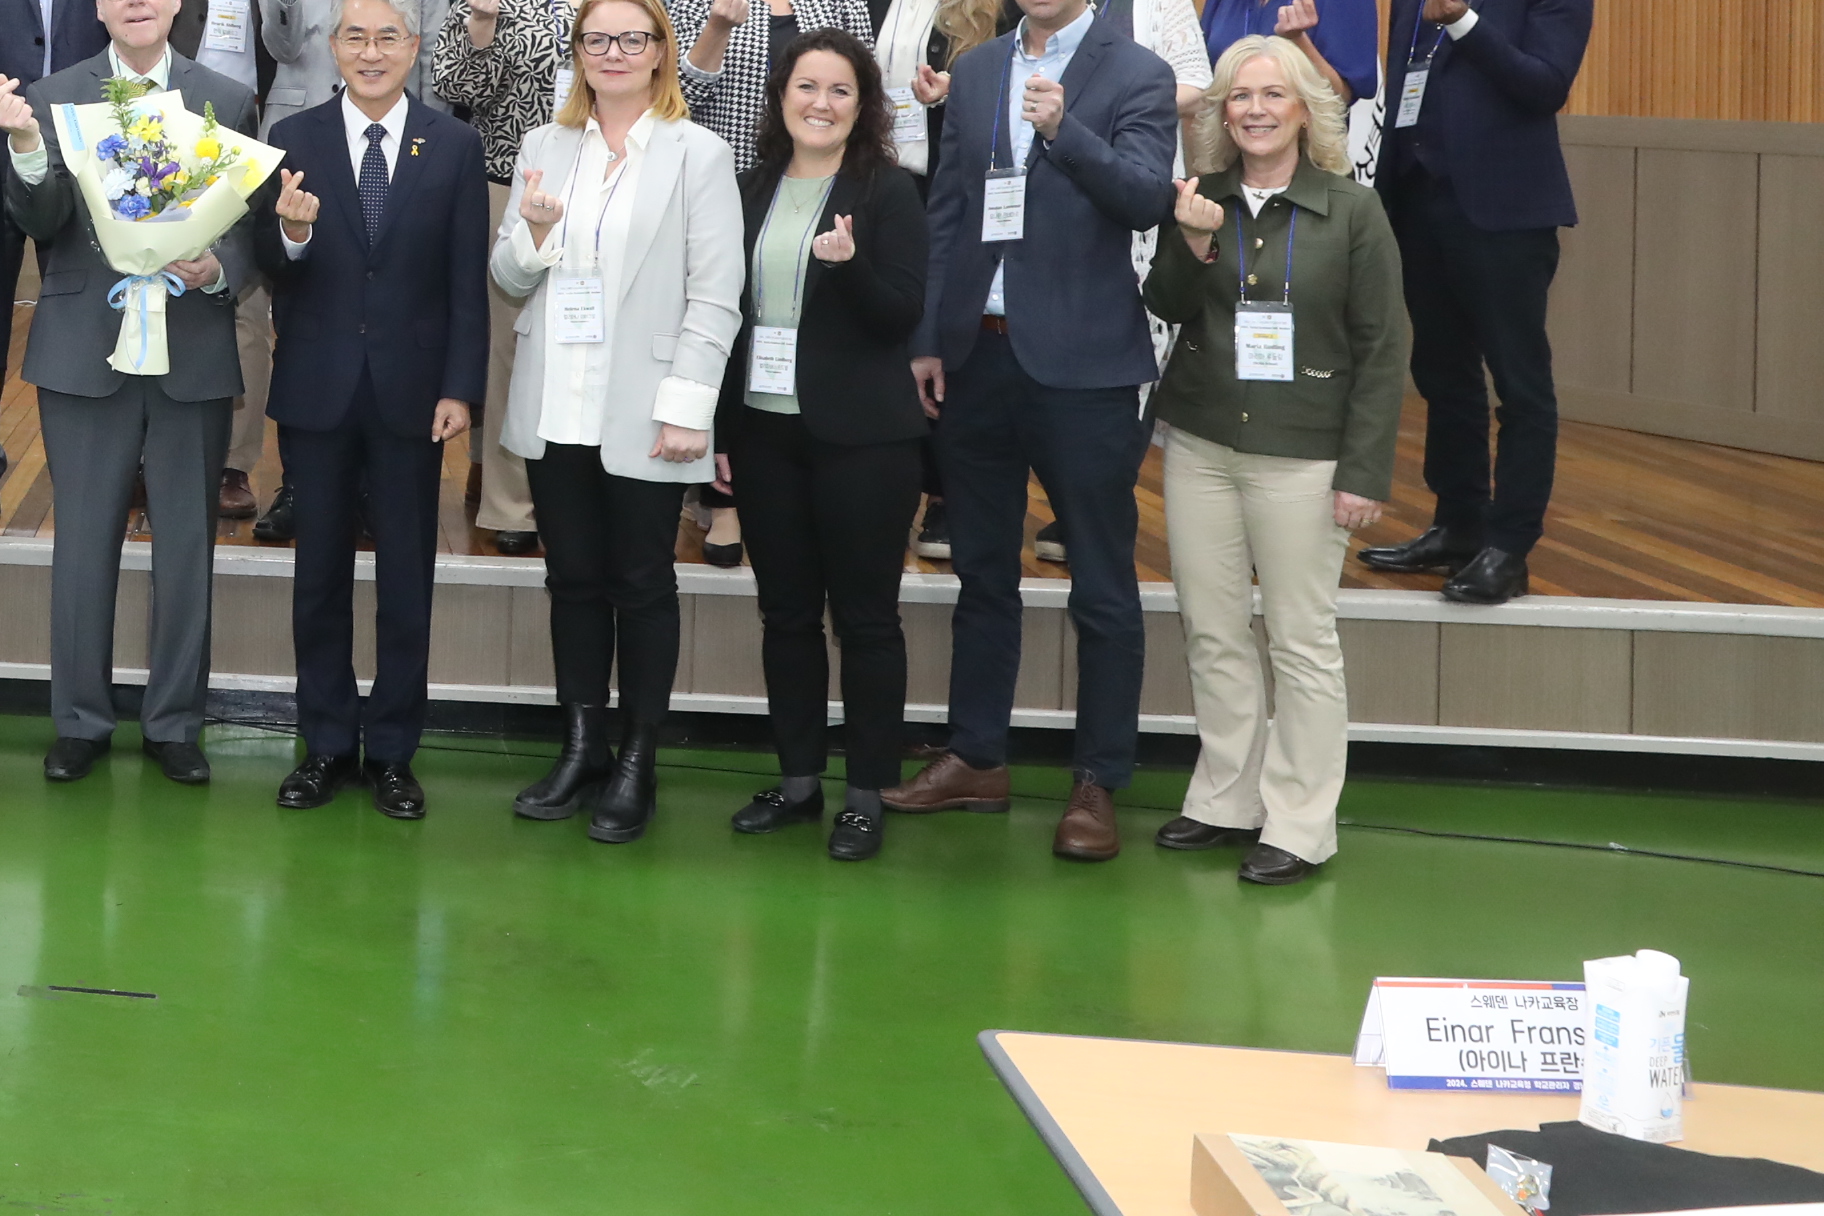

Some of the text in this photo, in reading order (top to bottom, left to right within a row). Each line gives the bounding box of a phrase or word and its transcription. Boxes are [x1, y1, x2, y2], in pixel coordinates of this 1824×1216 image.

[1470, 994, 1579, 1011] 스웨덴 나카교육장
[1426, 1017, 1495, 1044] Einar
[1458, 1049, 1584, 1074] (아이나 프란
[1649, 1055, 1668, 1068] DEEP
